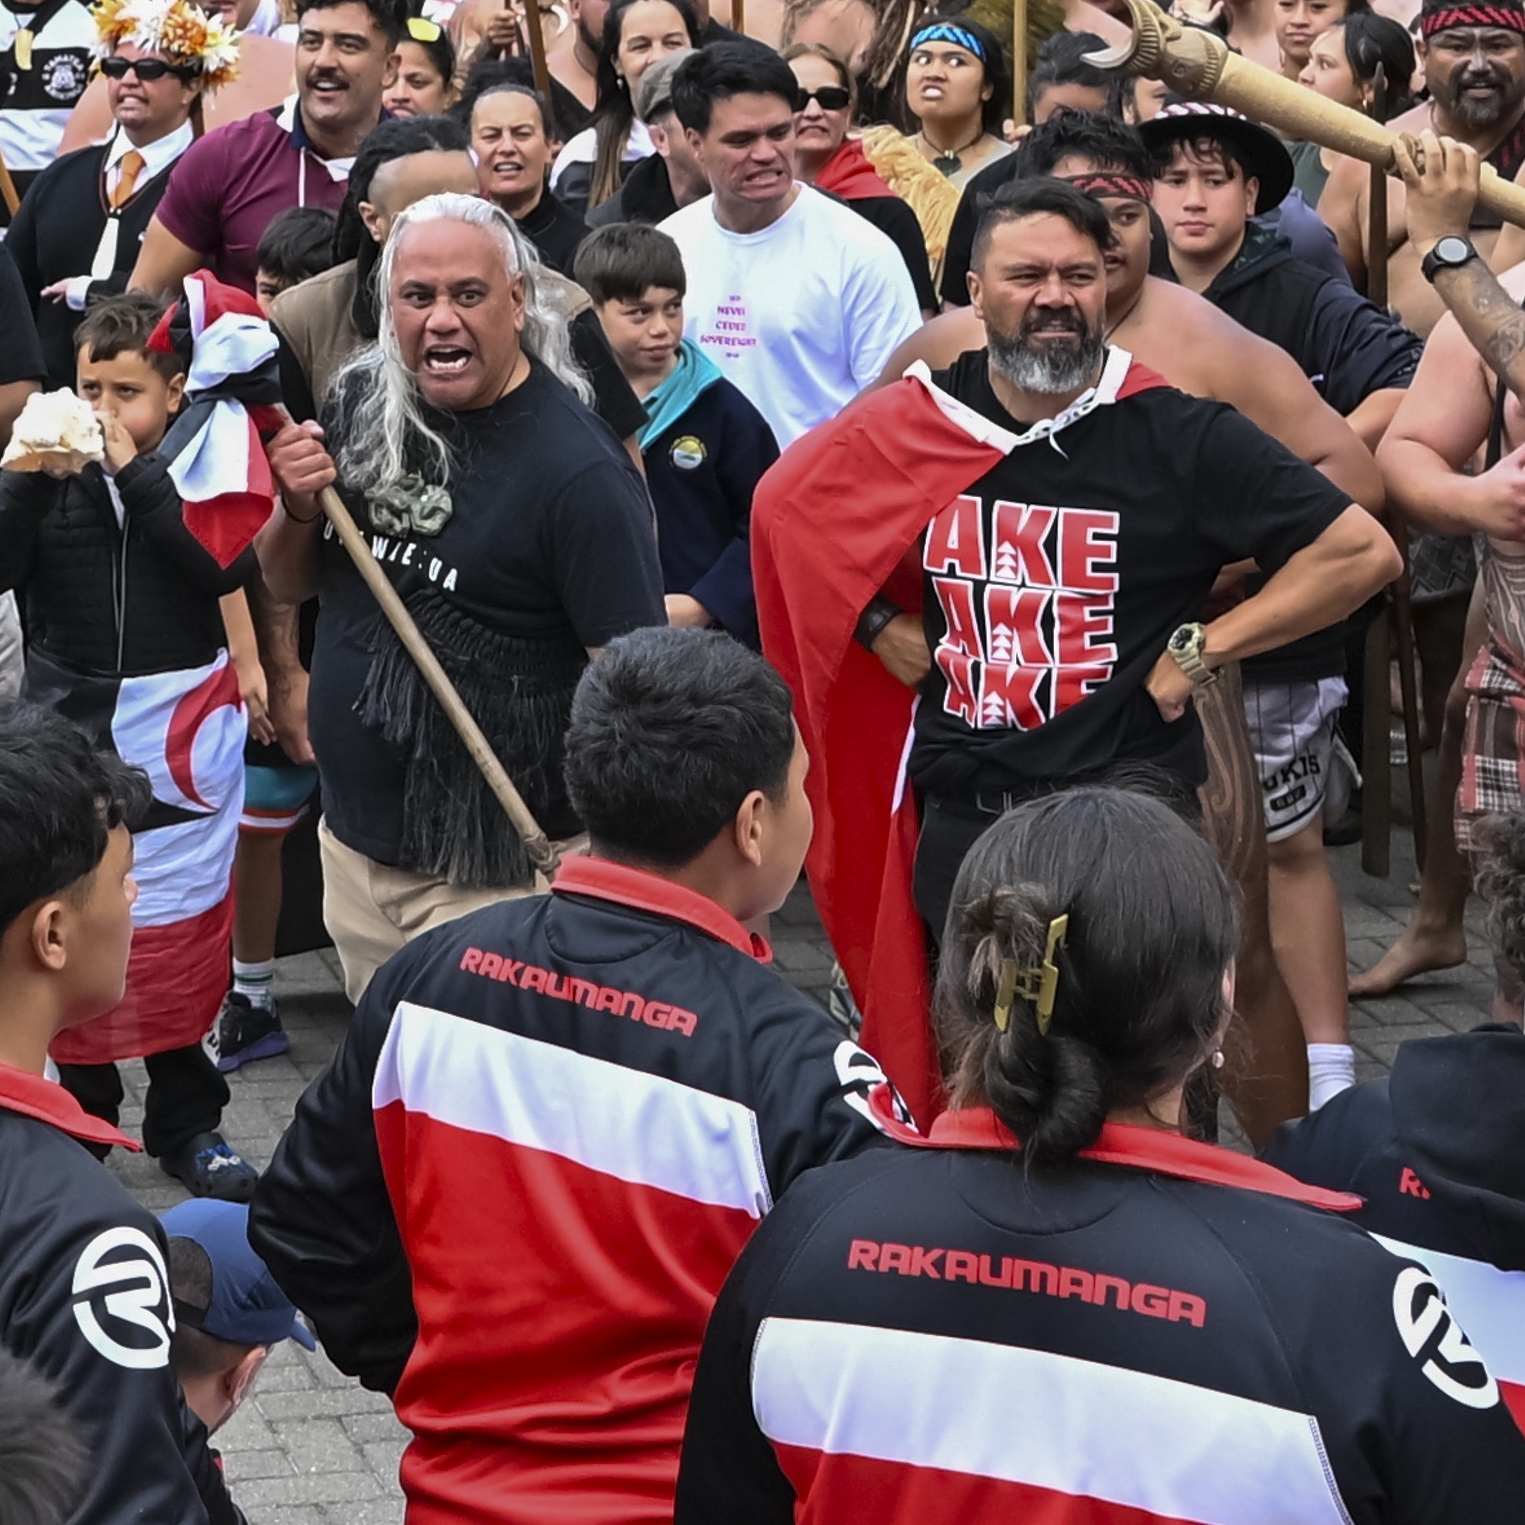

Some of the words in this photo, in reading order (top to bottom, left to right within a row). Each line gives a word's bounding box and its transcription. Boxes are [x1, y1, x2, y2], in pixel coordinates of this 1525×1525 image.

[923, 494, 1120, 594] AKE
[932, 575, 1119, 667] AKE
[934, 644, 1114, 732] AKE
[460, 946, 698, 1038] RAKAUMANGA
[847, 1238, 1208, 1328] RAKAUMANGA
